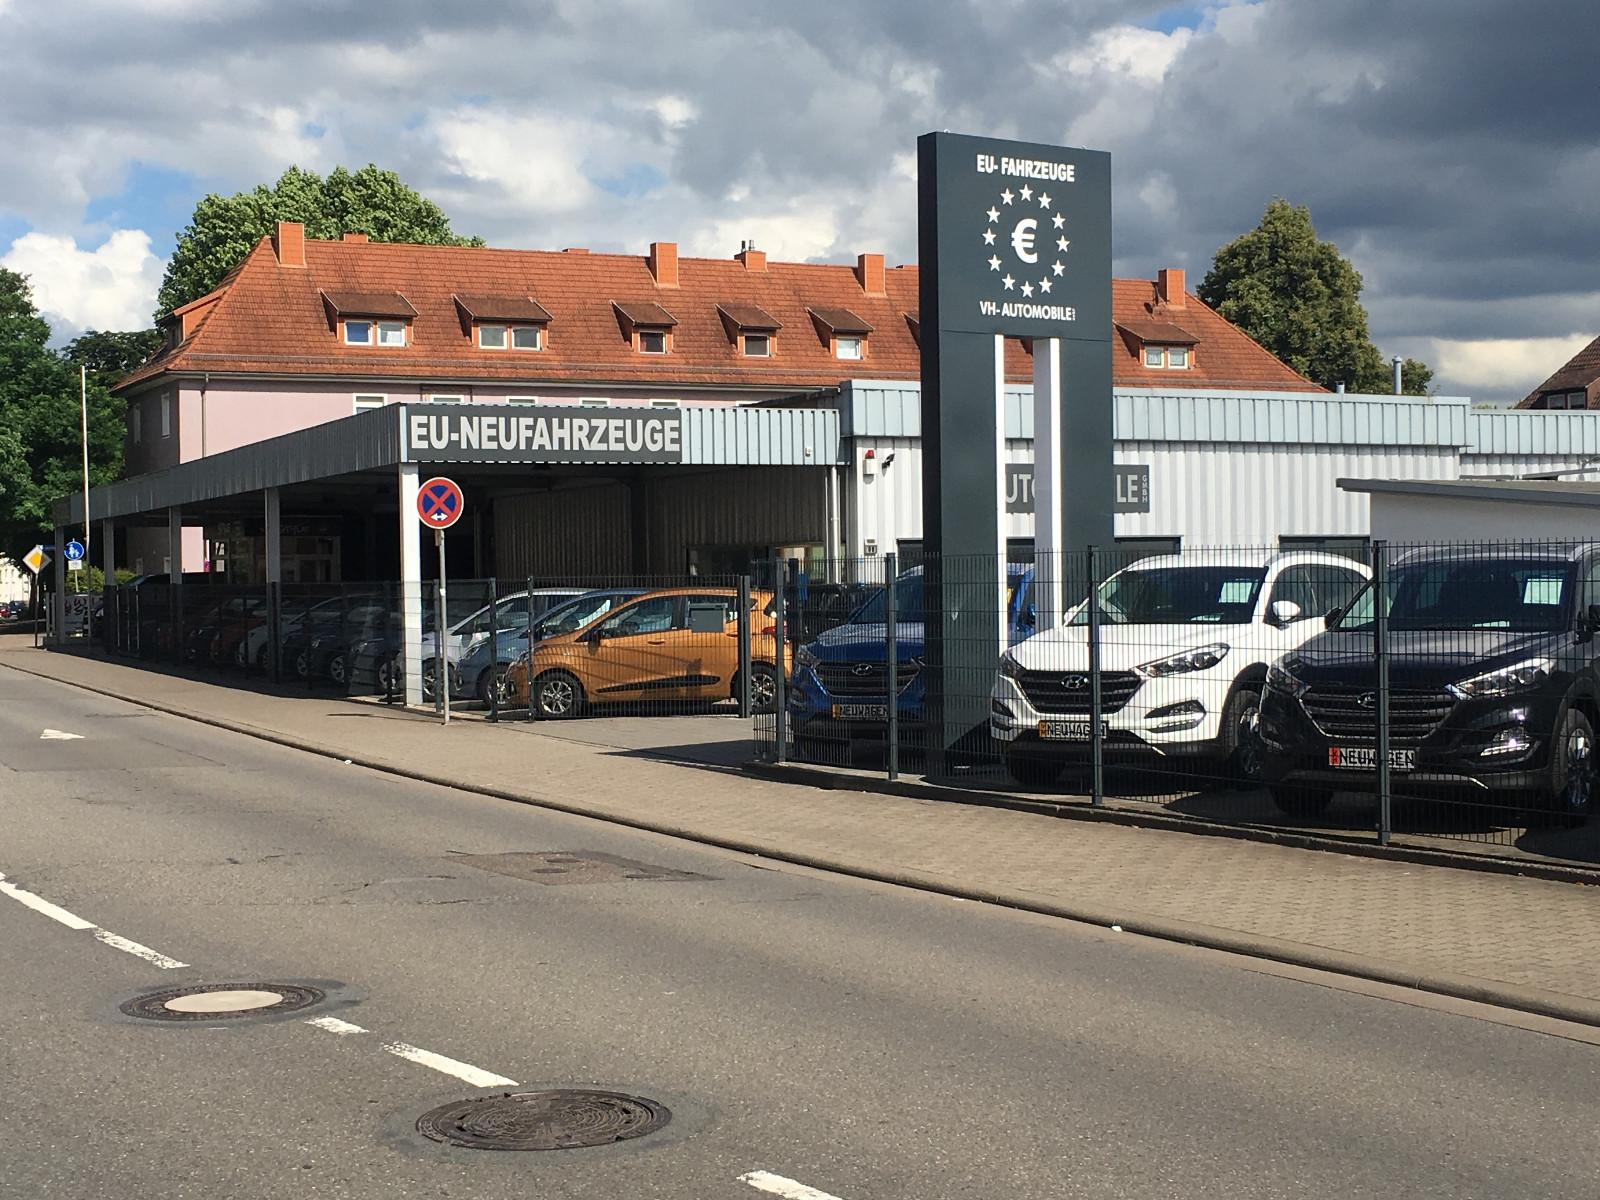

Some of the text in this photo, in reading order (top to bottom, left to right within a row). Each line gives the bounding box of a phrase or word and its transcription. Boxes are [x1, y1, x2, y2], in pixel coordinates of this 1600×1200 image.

[977, 155, 1075, 182] EU- FAHRZEUGE
[1011, 218, 1038, 264] €
[980, 301, 1000, 316] VH-
[1002, 302, 1072, 320] AUTOMOBILE
[411, 415, 680, 451] EU-NEUFAHRZEUGE
[1340, 748, 1415, 769] NEUWGEN
